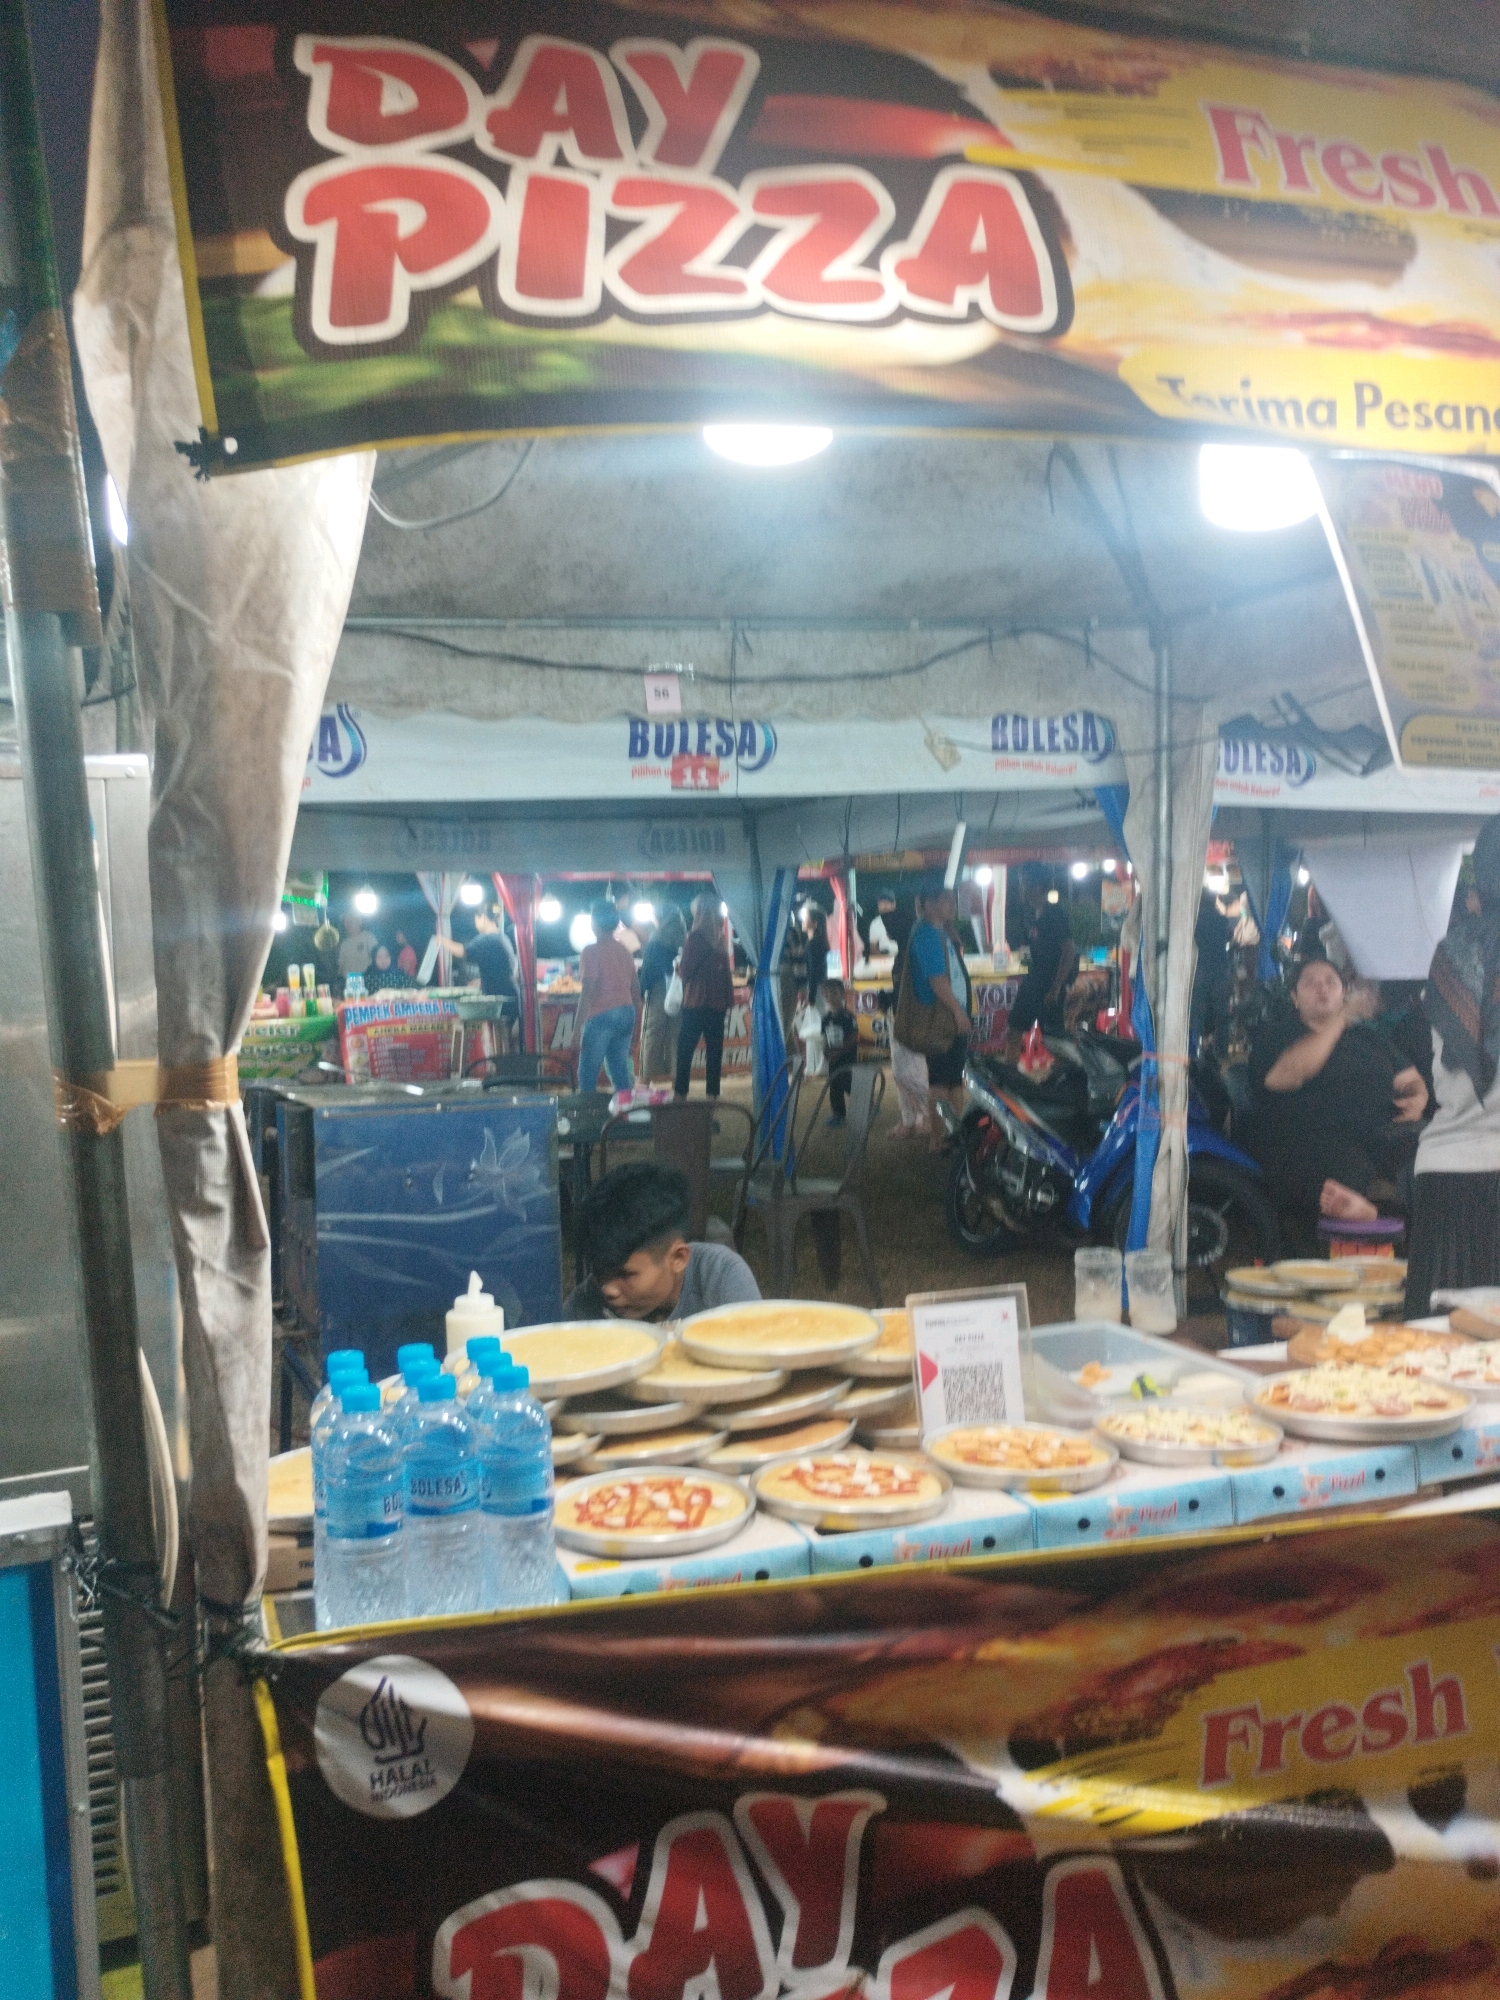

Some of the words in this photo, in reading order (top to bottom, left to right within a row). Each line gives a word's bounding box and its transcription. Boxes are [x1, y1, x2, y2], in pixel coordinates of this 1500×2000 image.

[294, 34, 760, 172] DAY
[1200, 98, 1500, 222] Fresh
[286, 153, 1063, 345] PIZZA
[682, 765, 709, 787] 11
[369, 1759, 436, 1792] HALAL
[1200, 1658, 1468, 1792] Fresh
[433, 1790, 887, 2000] DAY
